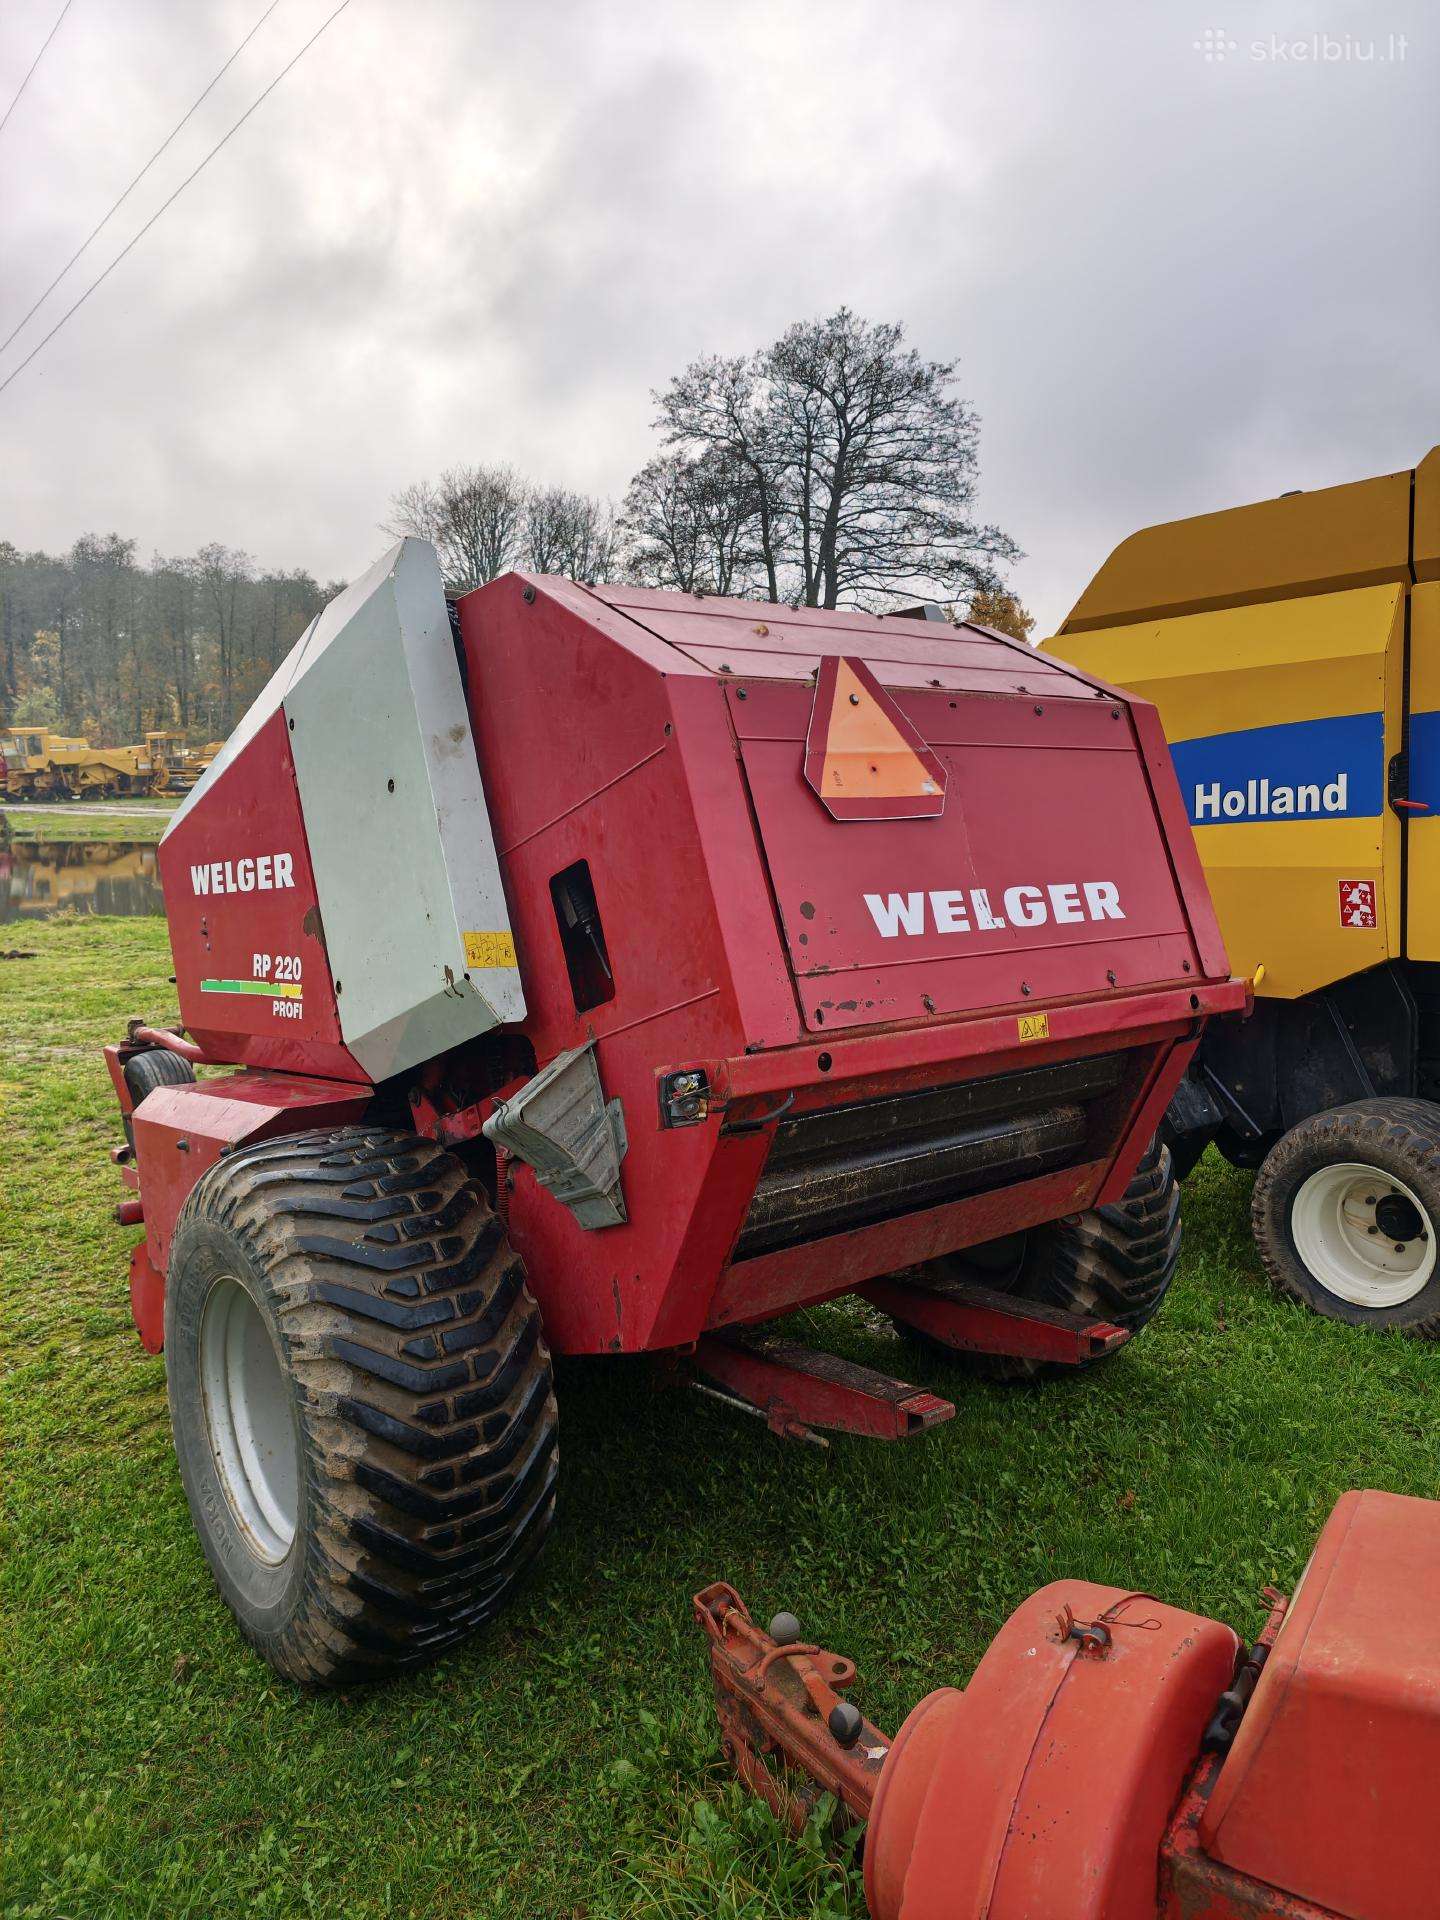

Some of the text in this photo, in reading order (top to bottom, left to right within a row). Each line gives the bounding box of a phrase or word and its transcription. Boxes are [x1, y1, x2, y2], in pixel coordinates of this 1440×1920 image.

[1195, 773, 1348, 819] Holland
[190, 853, 296, 896] WELGER
[862, 881, 1126, 938] WELGER
[253, 953, 302, 981] RP 220
[272, 1000, 303, 1020] PROFI
